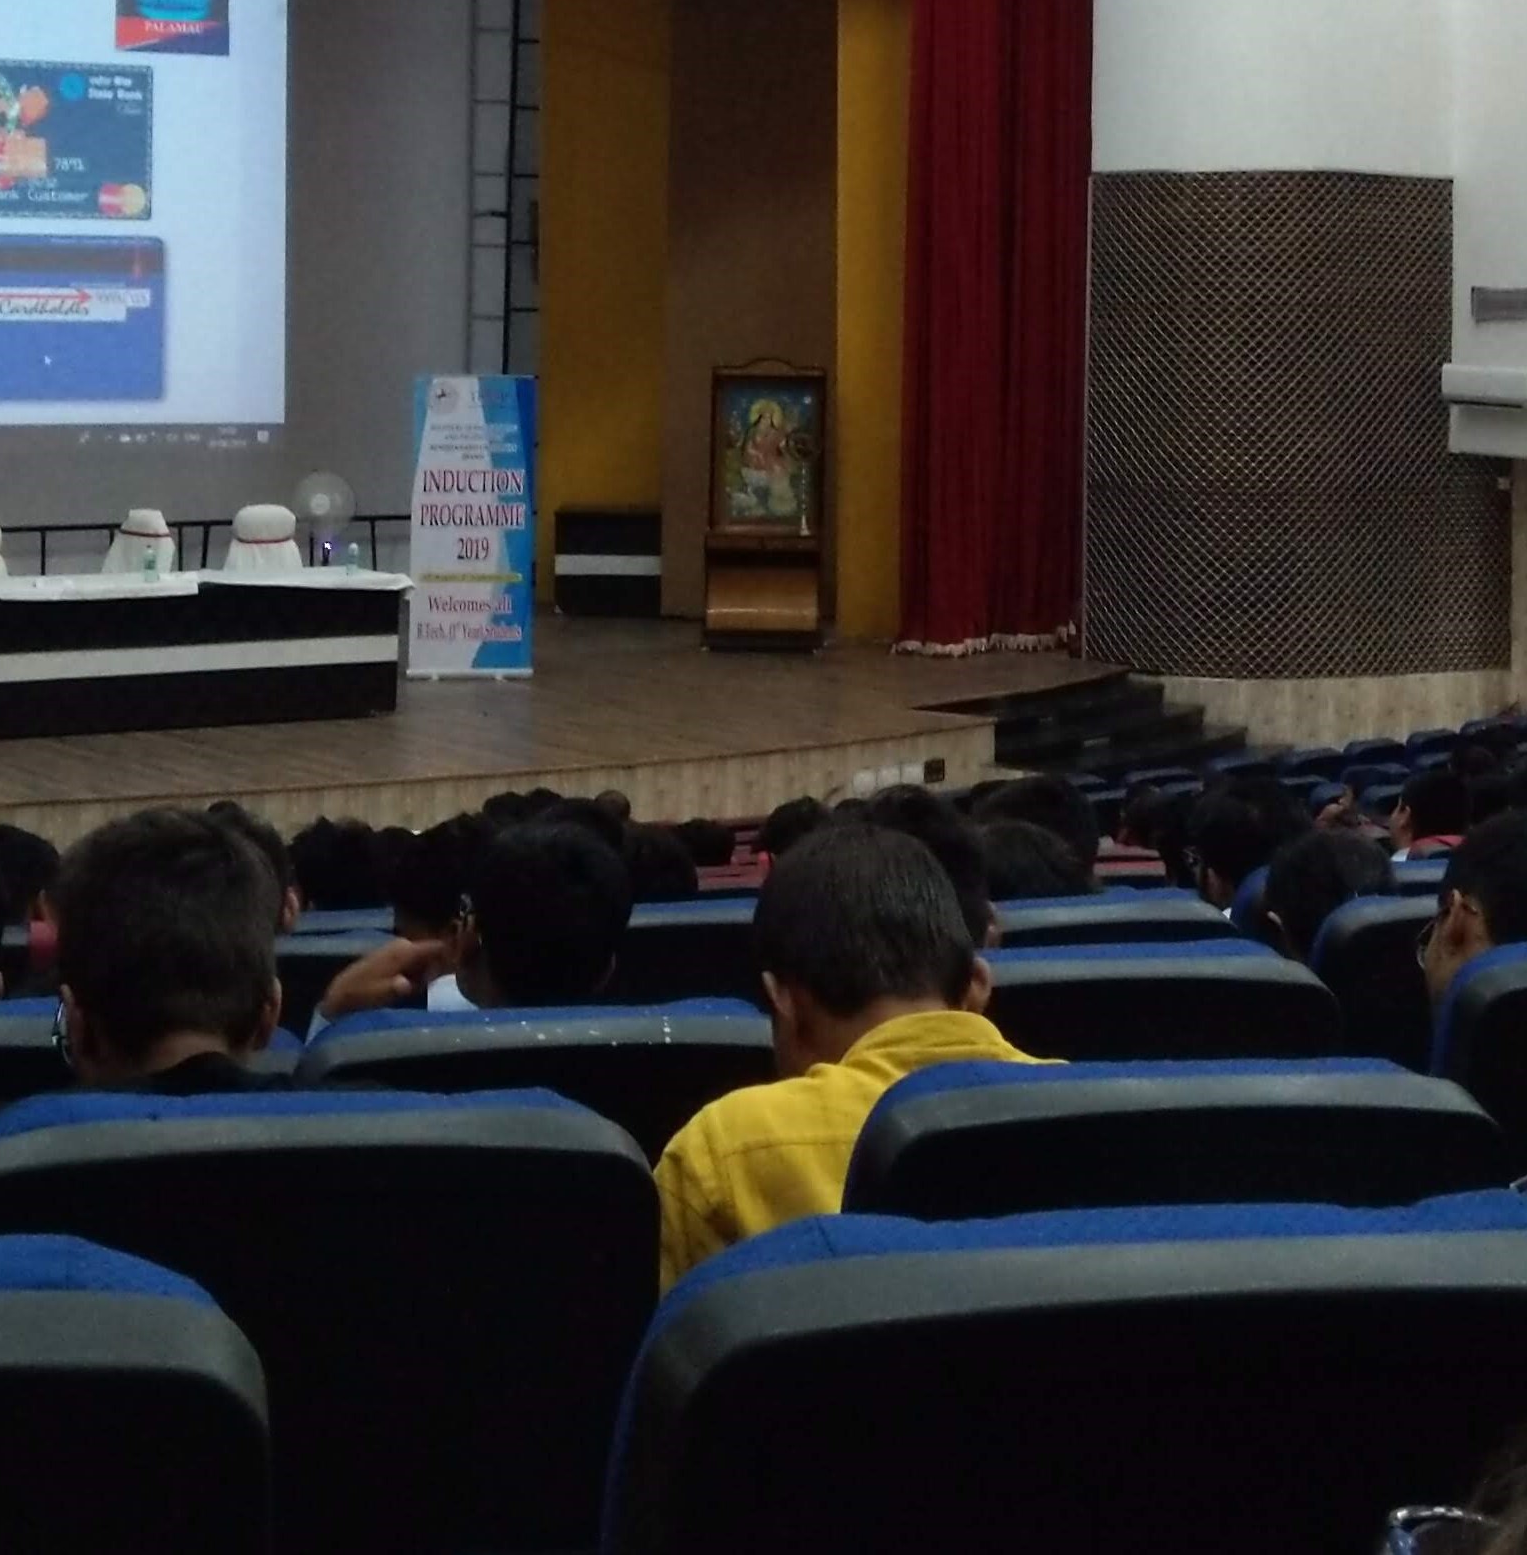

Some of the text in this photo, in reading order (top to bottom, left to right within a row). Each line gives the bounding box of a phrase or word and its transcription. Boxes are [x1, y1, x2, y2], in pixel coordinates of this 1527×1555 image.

[423, 468, 523, 494] INDUCTION
[420, 502, 524, 528] PROGRAMME
[457, 537, 489, 561] 2019
[428, 595, 491, 614] Welcomes
